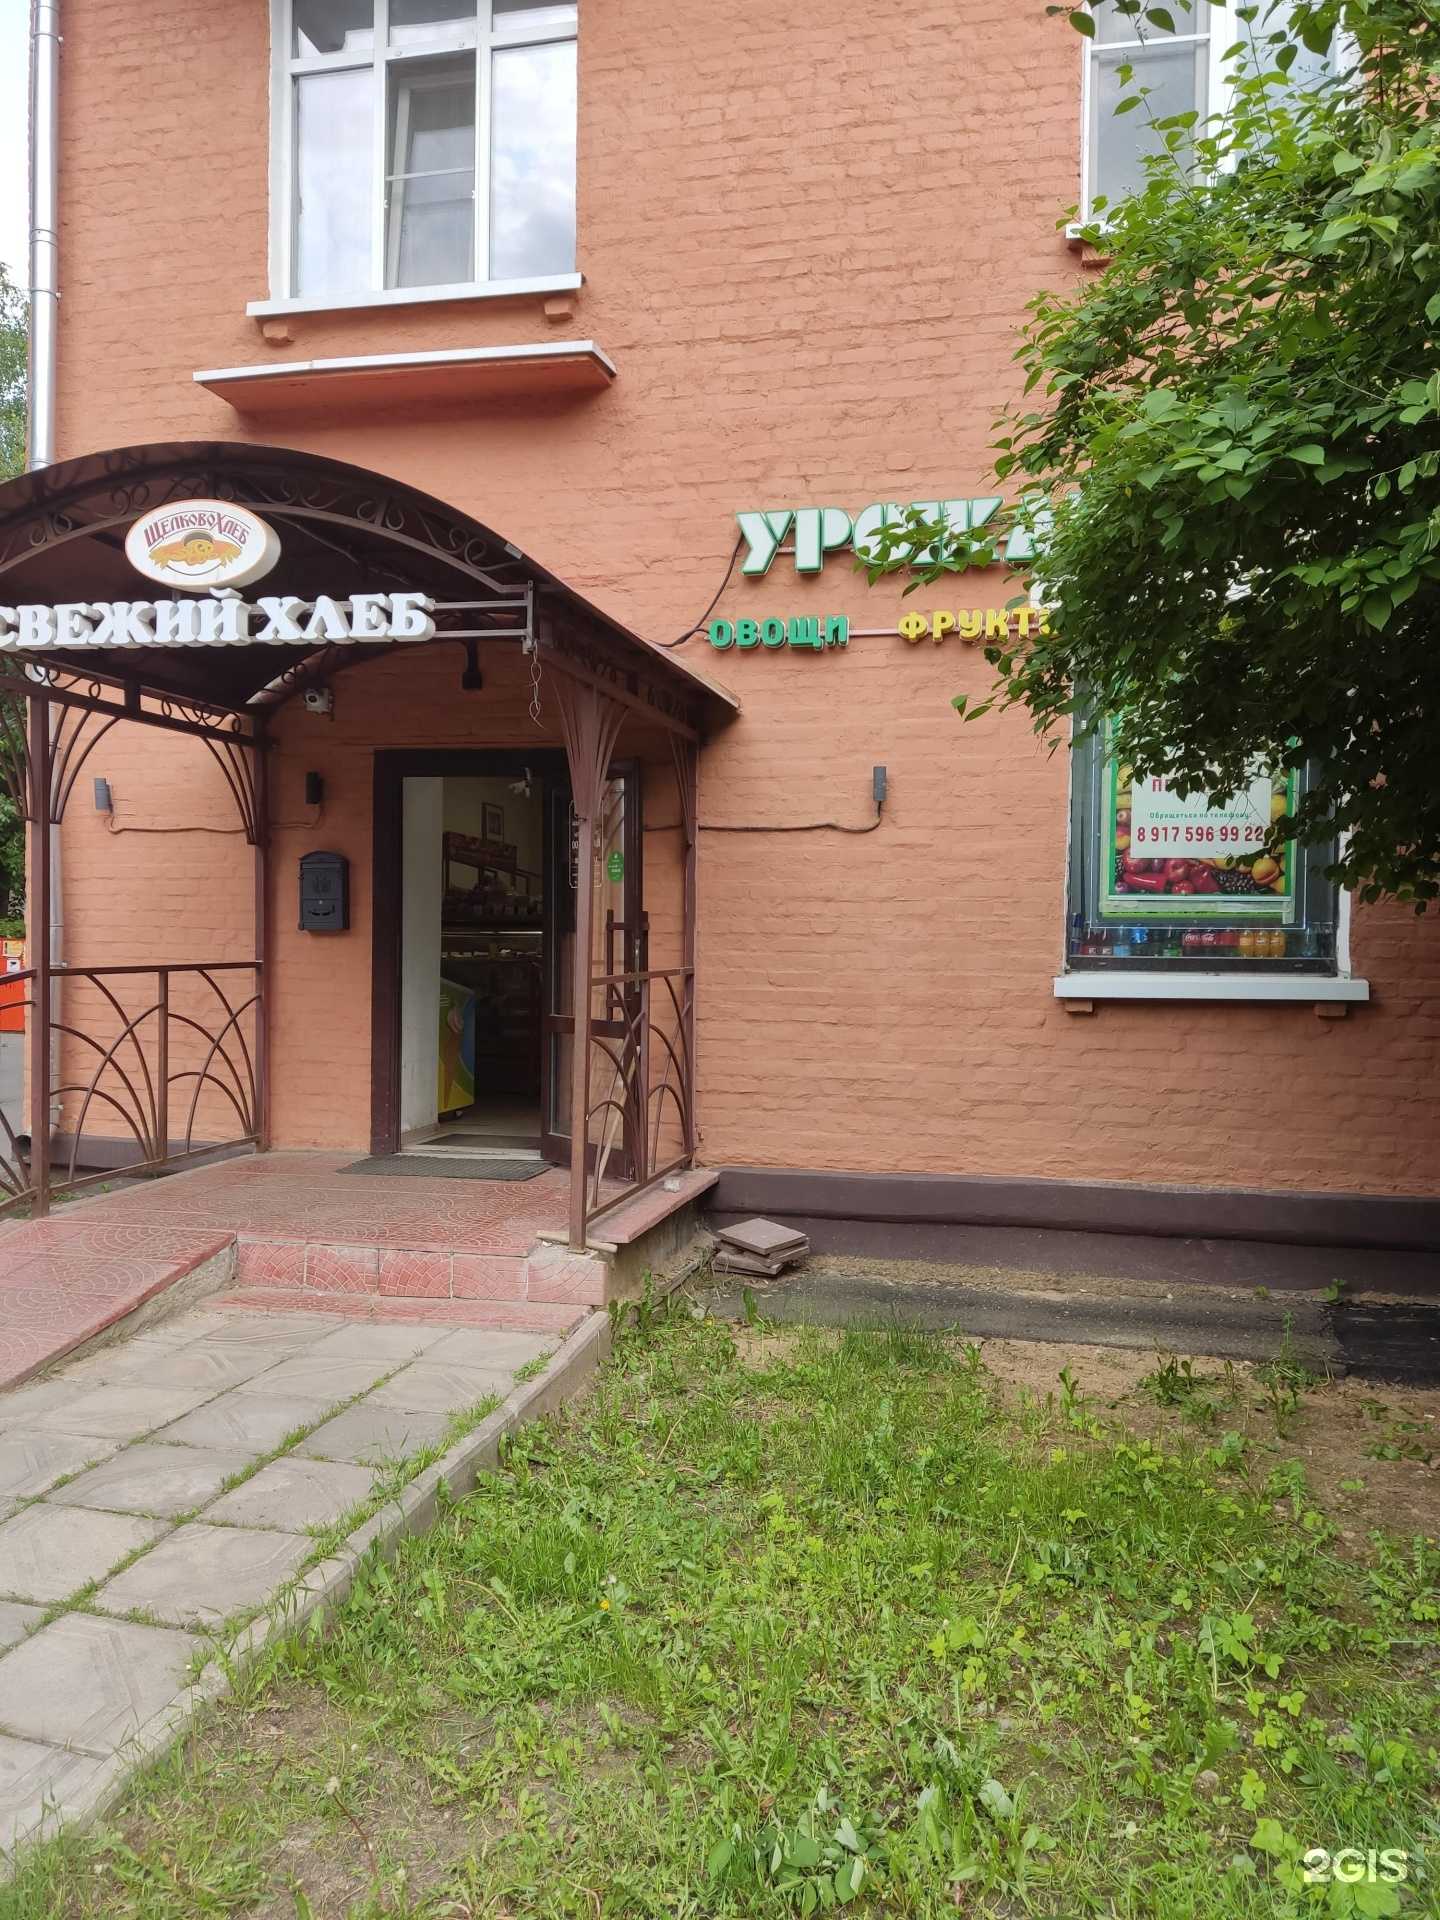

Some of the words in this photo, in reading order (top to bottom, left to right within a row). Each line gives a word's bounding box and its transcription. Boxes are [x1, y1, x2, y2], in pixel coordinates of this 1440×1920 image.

[0, 587, 251, 651] СВЕЖИЙ
[256, 592, 436, 646] ХЛЕБ
[708, 615, 851, 650] ОВОЩИ
[1137, 826, 1146, 842] 8
[1151, 826, 1180, 842] 917
[1185, 826, 1214, 842] 596
[1219, 826, 1239, 842] 99
